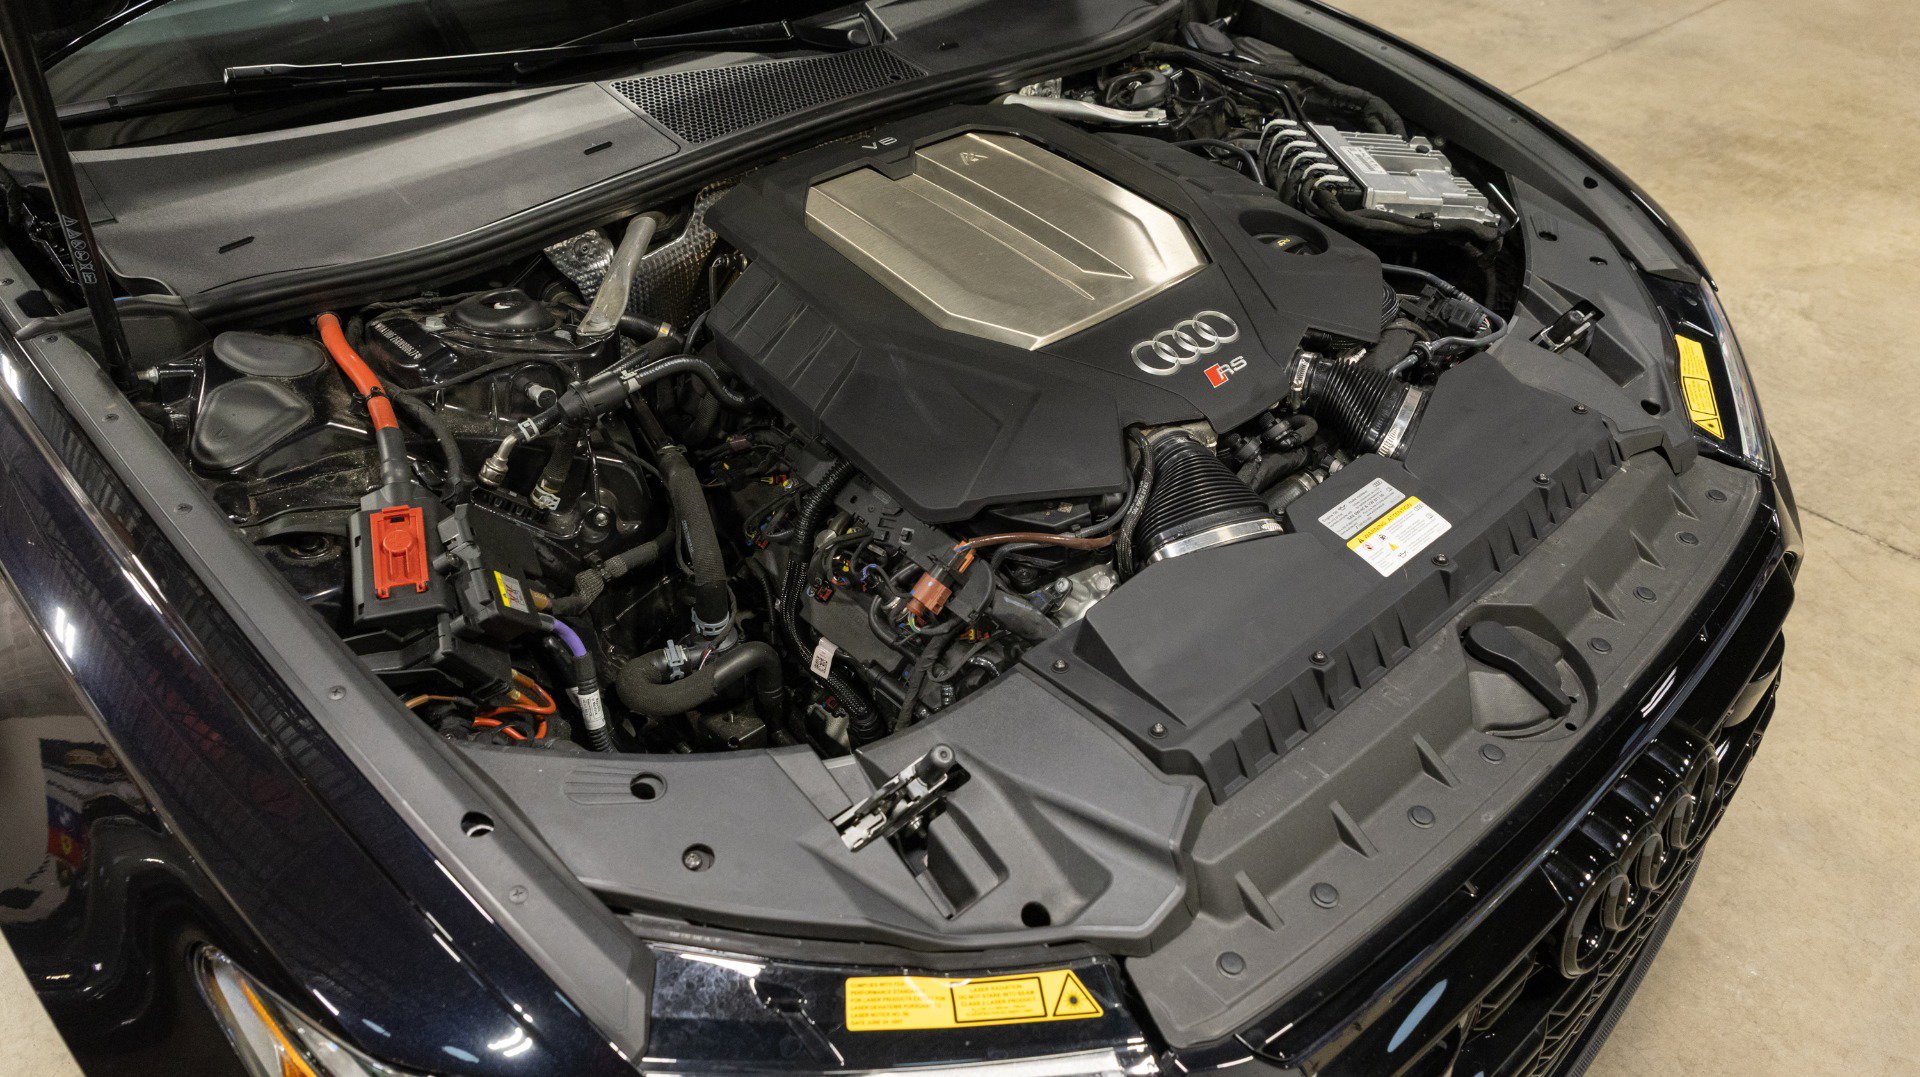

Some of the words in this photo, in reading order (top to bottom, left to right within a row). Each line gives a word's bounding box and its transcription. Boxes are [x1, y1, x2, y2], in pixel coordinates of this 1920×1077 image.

[1216, 355, 1248, 380] RS
[1364, 520, 1387, 539] WARNING
[1387, 503, 1413, 522] ATTENTION
